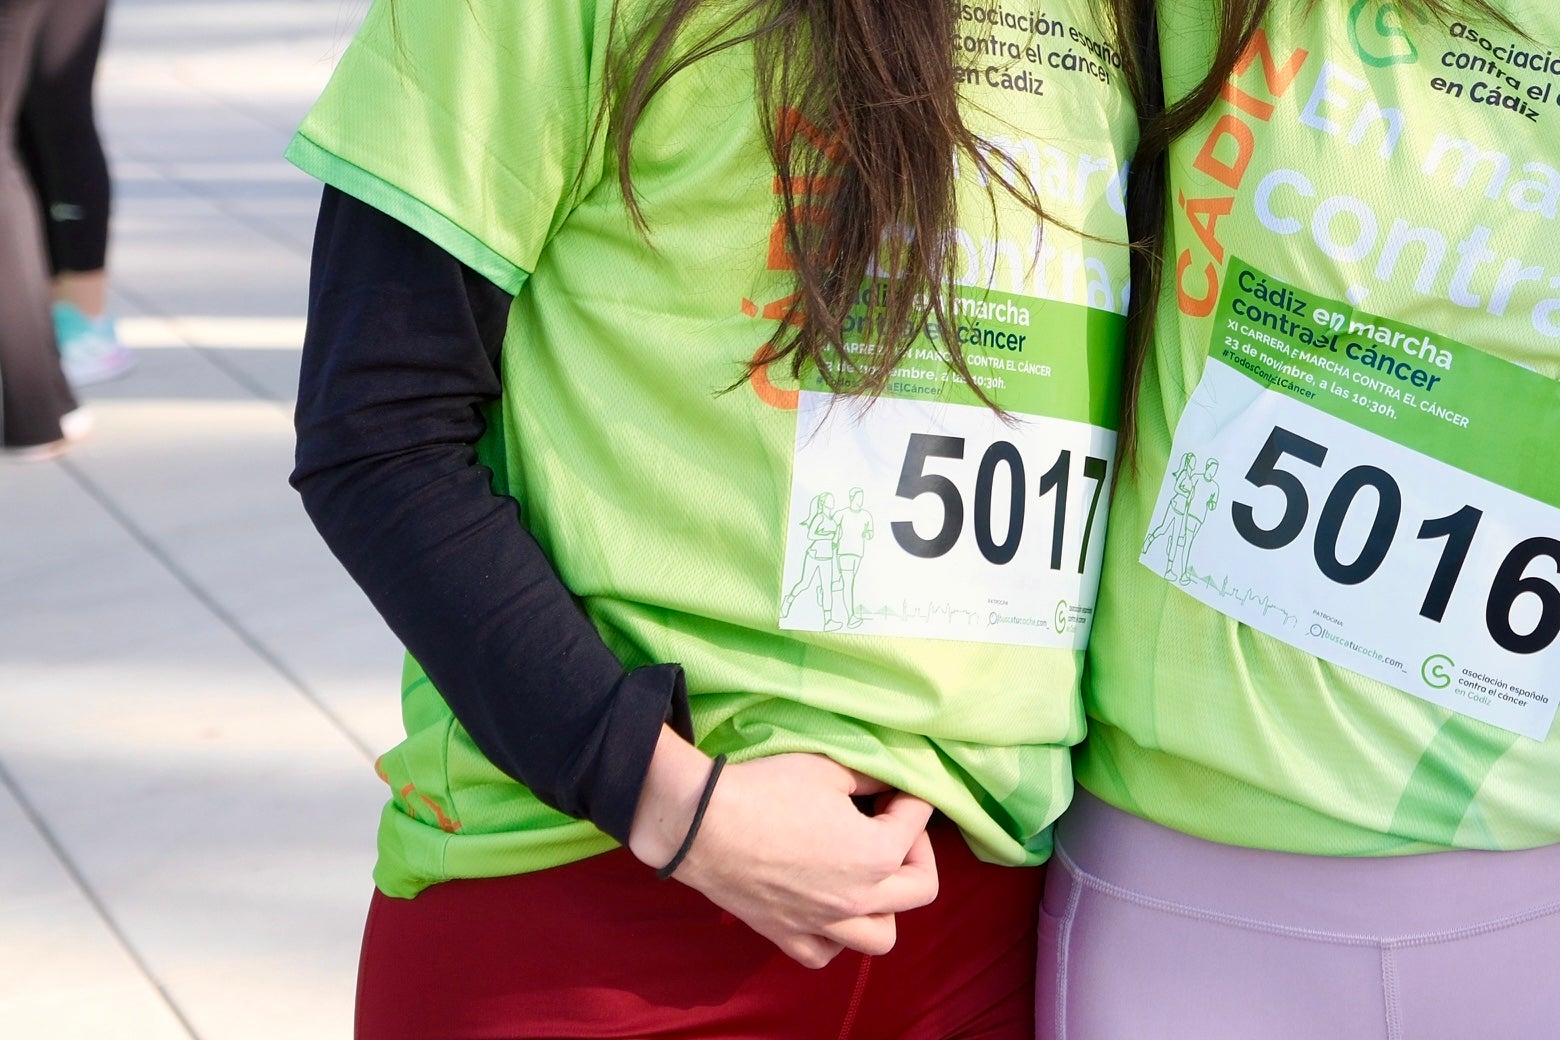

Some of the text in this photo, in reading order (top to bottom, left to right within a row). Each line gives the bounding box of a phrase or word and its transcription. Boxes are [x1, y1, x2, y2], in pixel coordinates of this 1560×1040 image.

[952, 33, 1110, 85] contra el cáncer
[1068, 26, 1122, 69] españo
[953, 65, 1044, 96] en Cádiz
[1430, 77, 1540, 123] en Cádiz
[1441, 51, 1521, 91] contra
[1527, 83, 1551, 103] el
[1299, 58, 1403, 159] En
[1176, 27, 1308, 318] CÁDIZ
[953, 297, 1031, 326] marcha
[1238, 270, 1453, 371] Cádiz en marcha
[958, 322, 1027, 353] cáncer
[1231, 298, 1314, 346] contra
[1345, 344, 1441, 392] cáncer
[941, 372, 949, 382] a
[967, 354, 1005, 370] CONTRA
[1006, 360, 1016, 372] EL
[1018, 360, 1052, 377] CÁNCER
[1224, 336, 1239, 351] 23
[1242, 343, 1258, 357] de
[1319, 379, 1328, 391] a
[1330, 381, 1350, 399] las
[1352, 392, 1398, 420] 10:30h.
[1227, 319, 1238, 331] XI
[1240, 325, 1290, 356] CARRERA
[1299, 351, 1350, 379] MARCHA
[1352, 372, 1401, 401] CONTRA
[1403, 394, 1417, 407] EL
[1420, 400, 1470, 429] CÁNCER
[891, 433, 1107, 574] 5017
[1454, 687, 1491, 706] en Cádiz
[1458, 677, 1528, 707] contra el cáncer
[1462, 667, 1550, 704] asociación española
